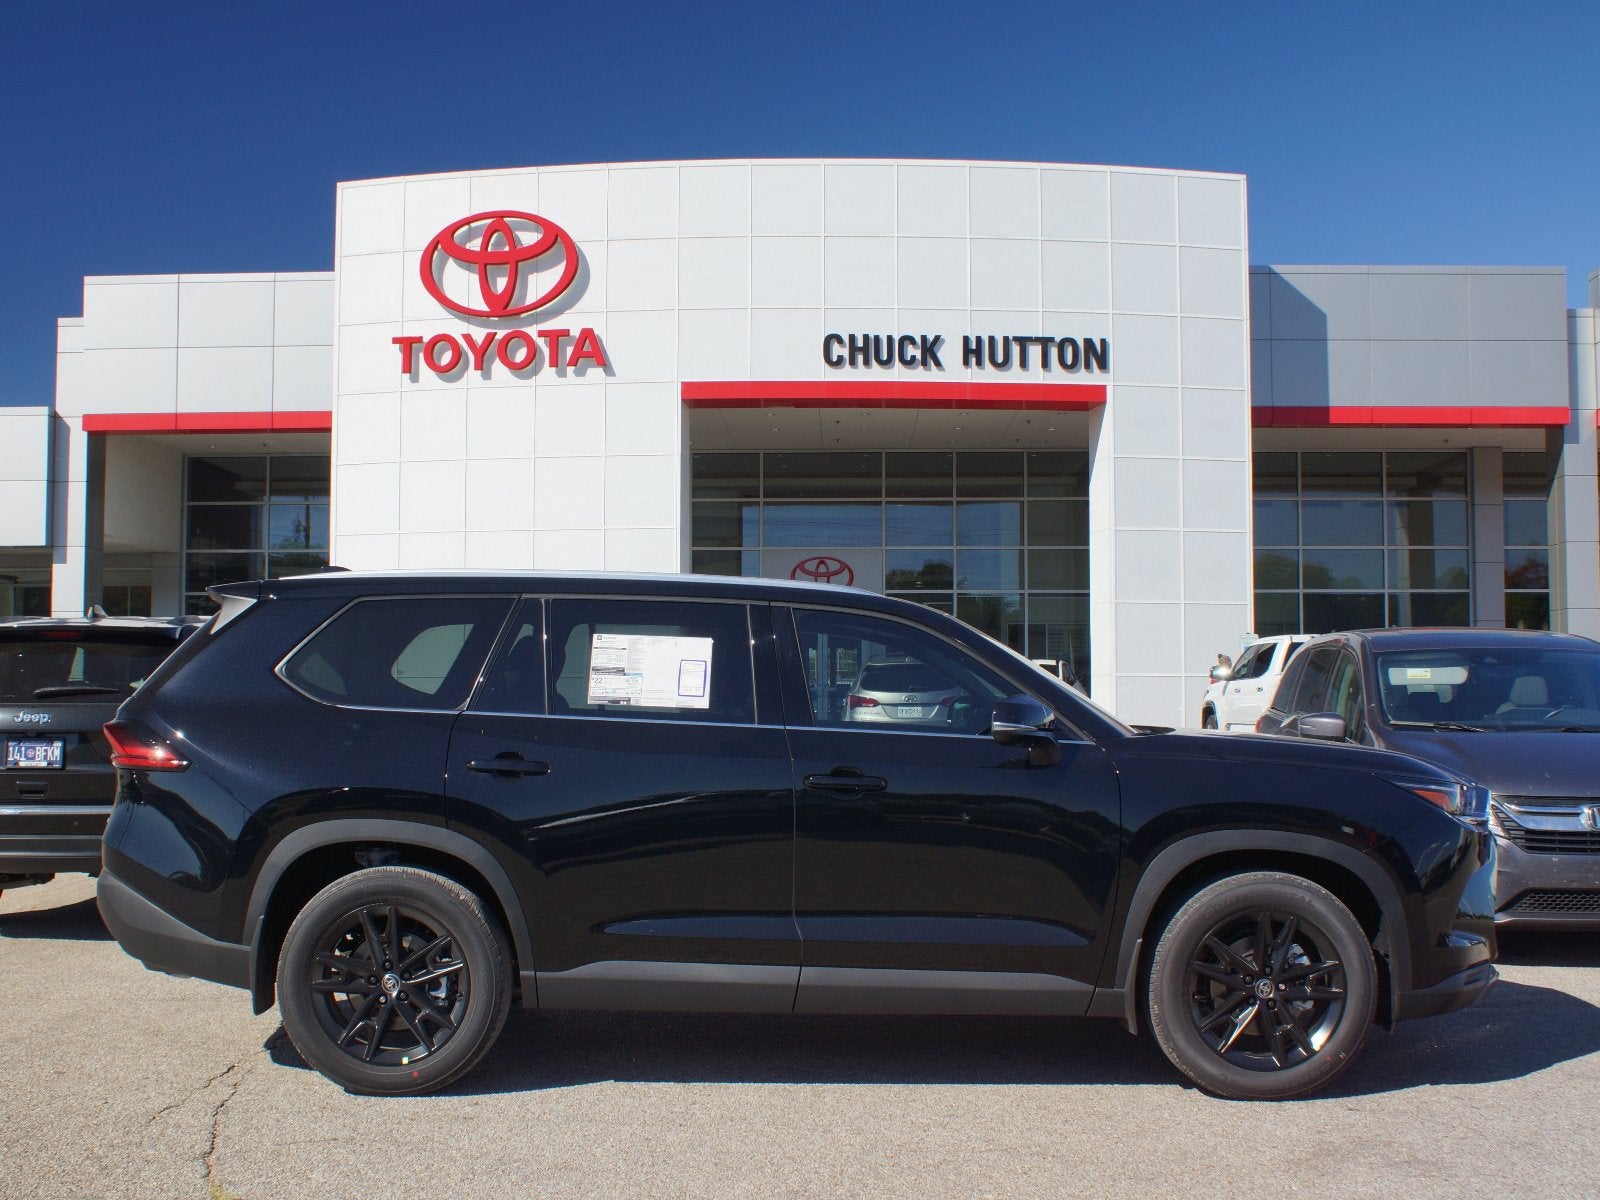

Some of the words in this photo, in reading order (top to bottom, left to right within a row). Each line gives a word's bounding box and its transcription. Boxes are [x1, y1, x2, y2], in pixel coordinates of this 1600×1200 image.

[392, 328, 607, 374] TOYOTA
[823, 333, 943, 368] CHUCK
[962, 335, 1108, 370] HUTTON
[14, 711, 49, 725] Jeep
[8, 746, 26, 760] 141
